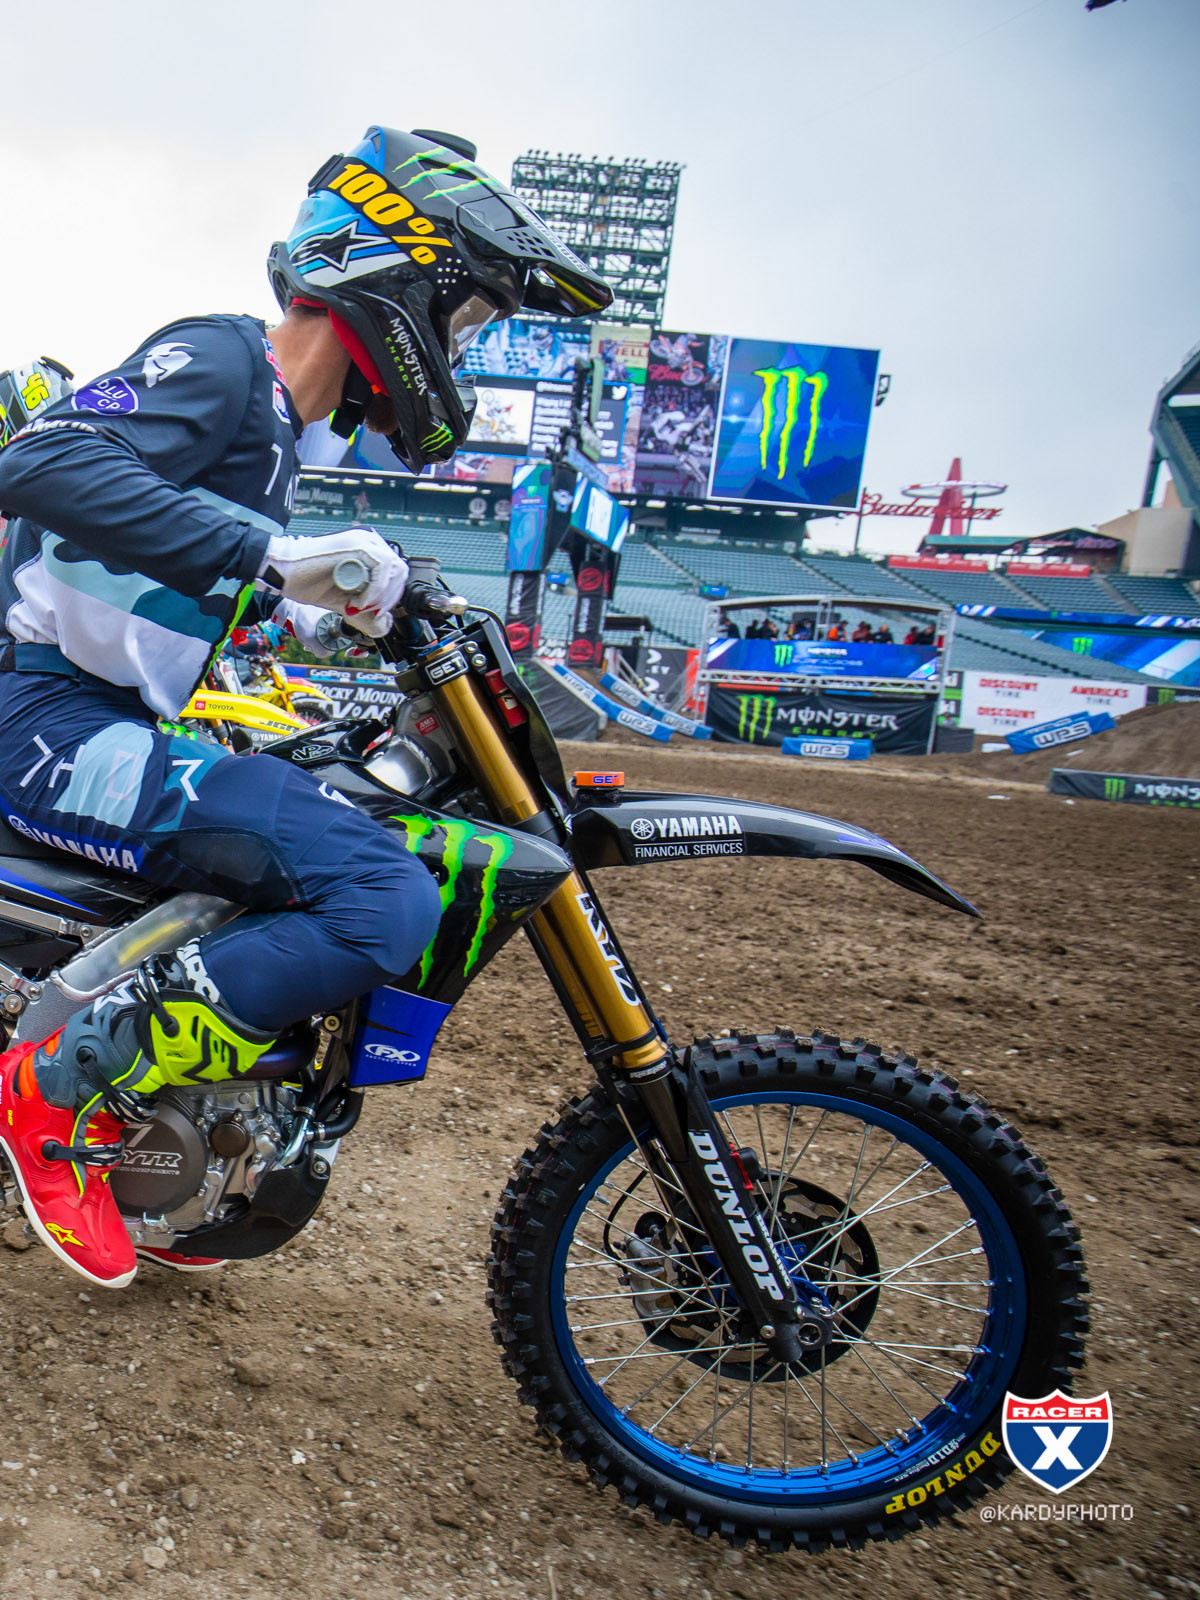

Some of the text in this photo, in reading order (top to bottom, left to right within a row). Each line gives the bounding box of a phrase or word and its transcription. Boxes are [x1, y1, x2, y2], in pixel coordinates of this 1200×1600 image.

[328, 164, 454, 265] 100%
[385, 336, 412, 389] ENERGY
[390, 317, 428, 396] MONSTER
[310, 669, 351, 678] GoPro
[356, 672, 395, 681] GoPro
[430, 656, 465, 680] GET
[979, 677, 1039, 692] DISCOUNT
[776, 706, 899, 731] MONSTER
[976, 706, 1036, 720] DISCOUNT
[792, 727, 878, 740] ENERGY
[802, 743, 849, 757] WPS
[593, 775, 618, 784] GET
[1134, 783, 1200, 800] MONS
[654, 816, 742, 838] YAMAHA
[33, 828, 138, 872] YAMAHA
[635, 843, 743, 858] FINANCIAL SERVICES
[126, 1123, 155, 1148] 7
[122, 1149, 184, 1168] YTR
[688, 1131, 784, 1300] DUNLOP
[756, 1213, 792, 1289] BRAKING
[885, 1431, 1002, 1515] DUNLOP
